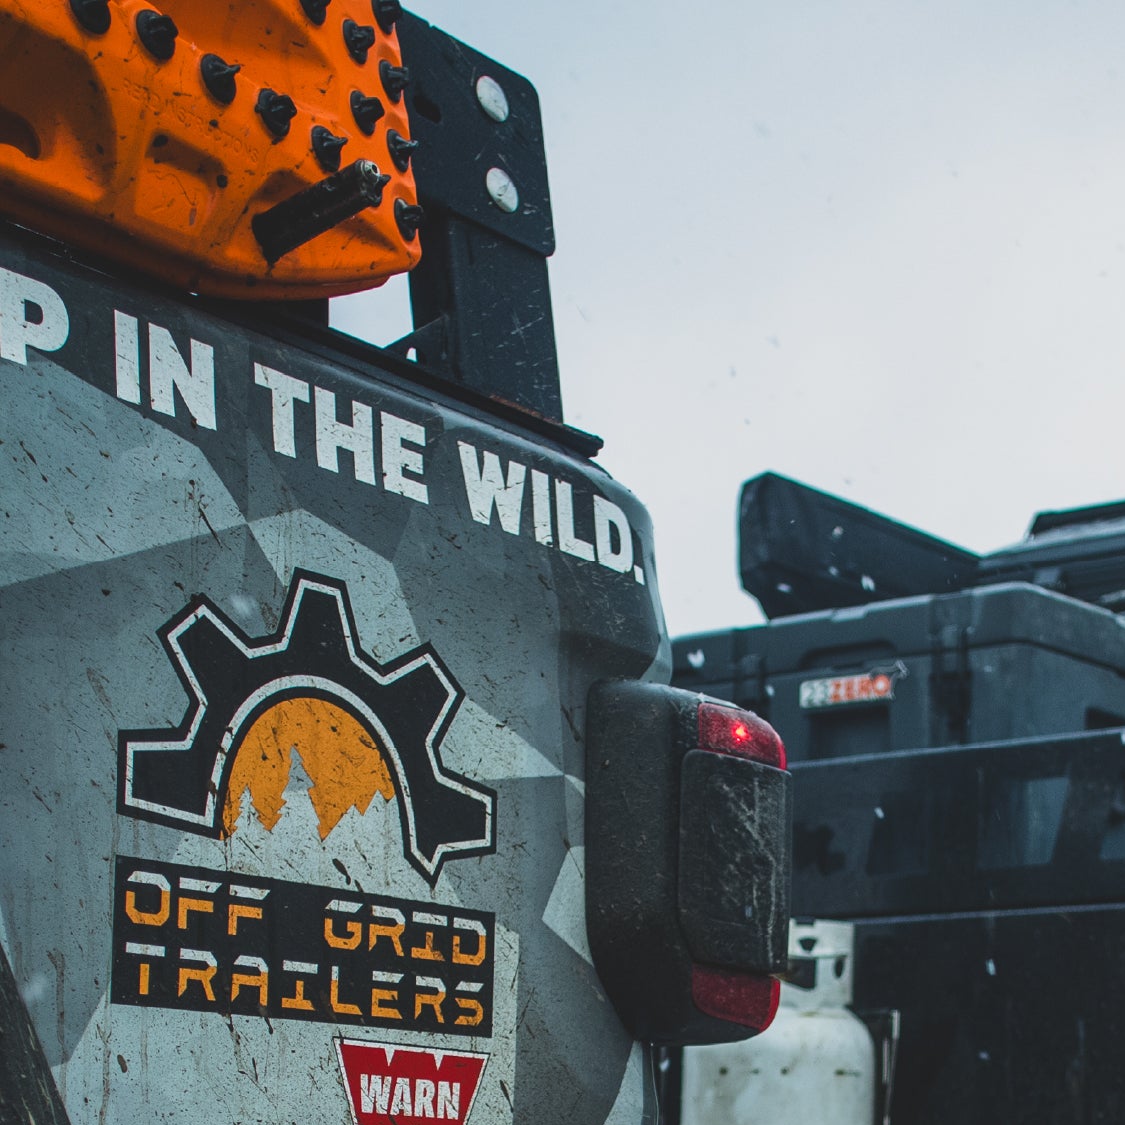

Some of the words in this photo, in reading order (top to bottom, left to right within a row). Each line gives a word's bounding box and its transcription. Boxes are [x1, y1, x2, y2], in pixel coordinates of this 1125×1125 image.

[114, 309, 217, 430] IN
[254, 362, 428, 504] THE
[457, 441, 645, 584] WILD.
[125, 870, 271, 936] OFF
[324, 899, 487, 966] GRID
[125, 941, 485, 1027] TRAILERS
[359, 1073, 460, 1120] WARN
